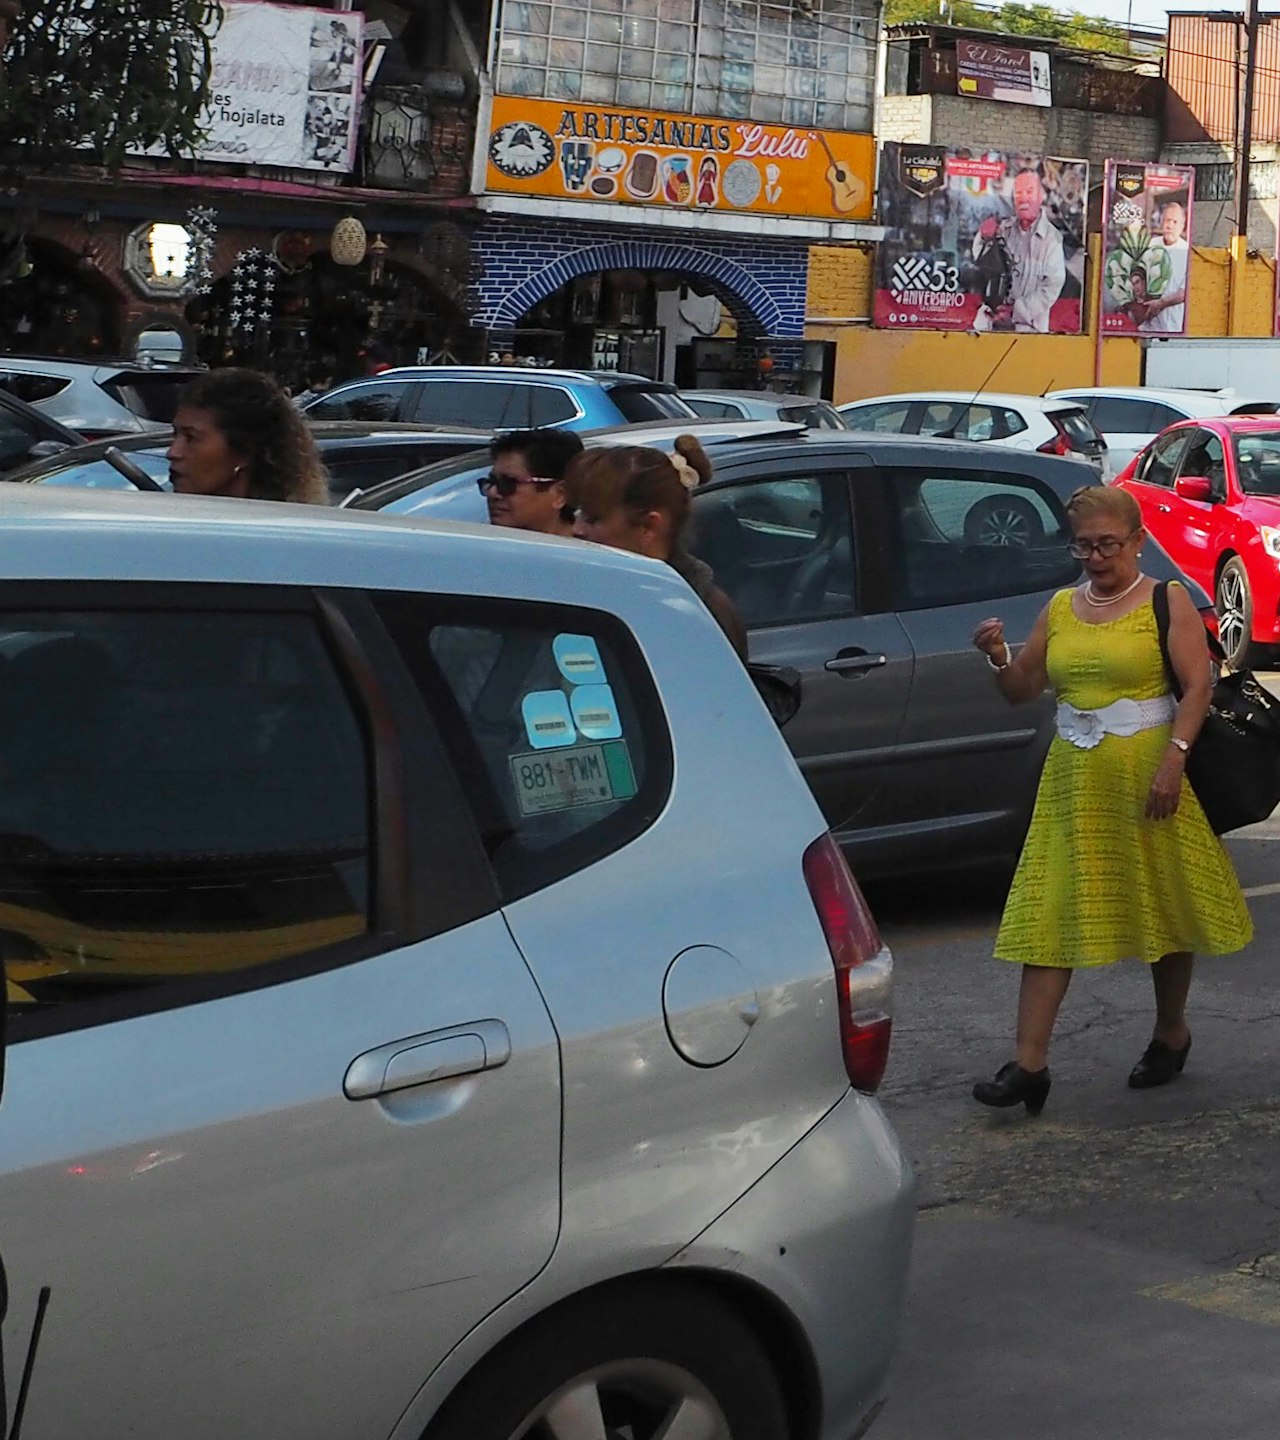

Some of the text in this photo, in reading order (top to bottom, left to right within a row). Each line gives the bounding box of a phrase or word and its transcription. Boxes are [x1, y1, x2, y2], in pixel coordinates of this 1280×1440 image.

[966, 44, 987, 60] El
[221, 107, 285, 127] hojalata
[555, 110, 731, 152] ARTESANIAS
[928, 260, 960, 292] 53
[902, 290, 966, 307] ANIVERSARIO
